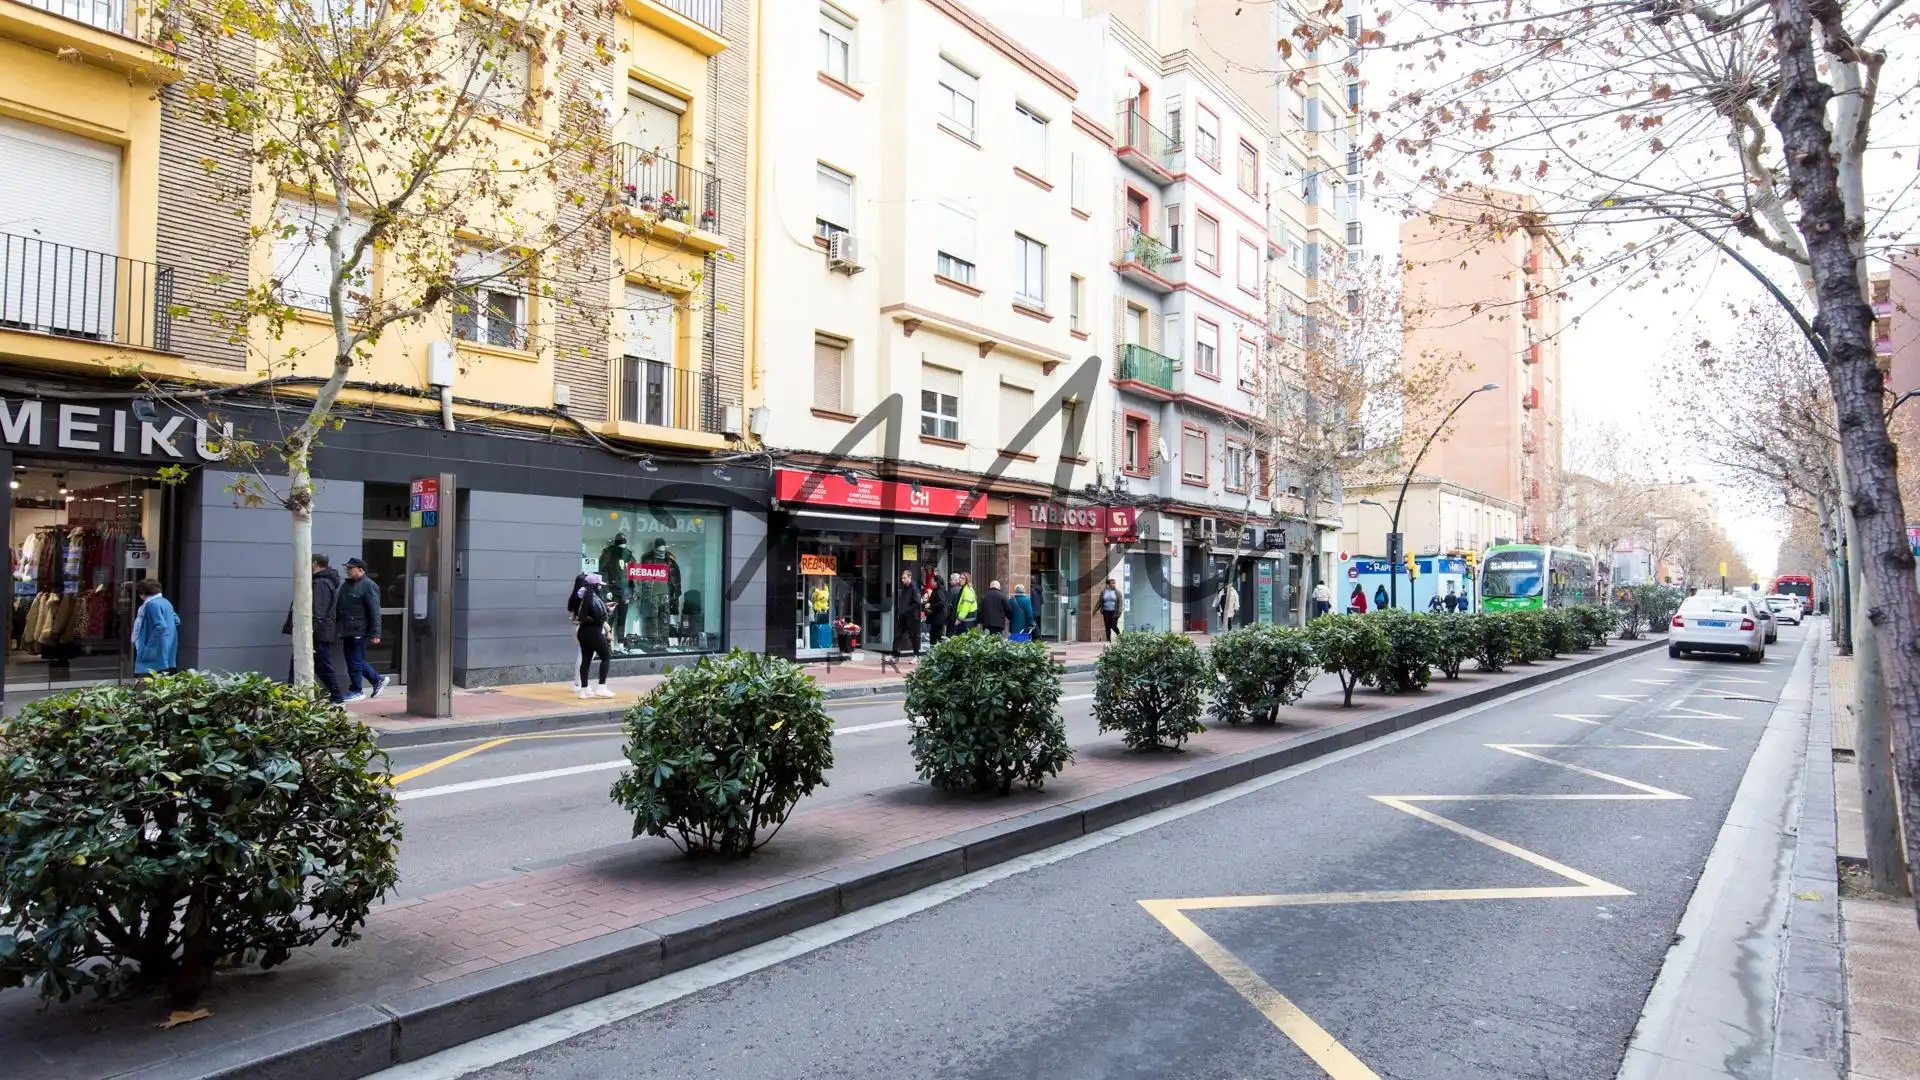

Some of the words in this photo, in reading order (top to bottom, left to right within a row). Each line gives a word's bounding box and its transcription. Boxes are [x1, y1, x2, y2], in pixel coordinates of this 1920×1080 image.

[0, 397, 234, 462] MEIKU
[412, 481, 423, 494] BUS
[424, 494, 435, 509] 32
[910, 490, 929, 506] CH
[424, 512, 436, 526] N3
[1029, 505, 1098, 527] TABACOS
[802, 557, 836, 572] REBAJAS
[629, 567, 667, 579] REBAJAS
